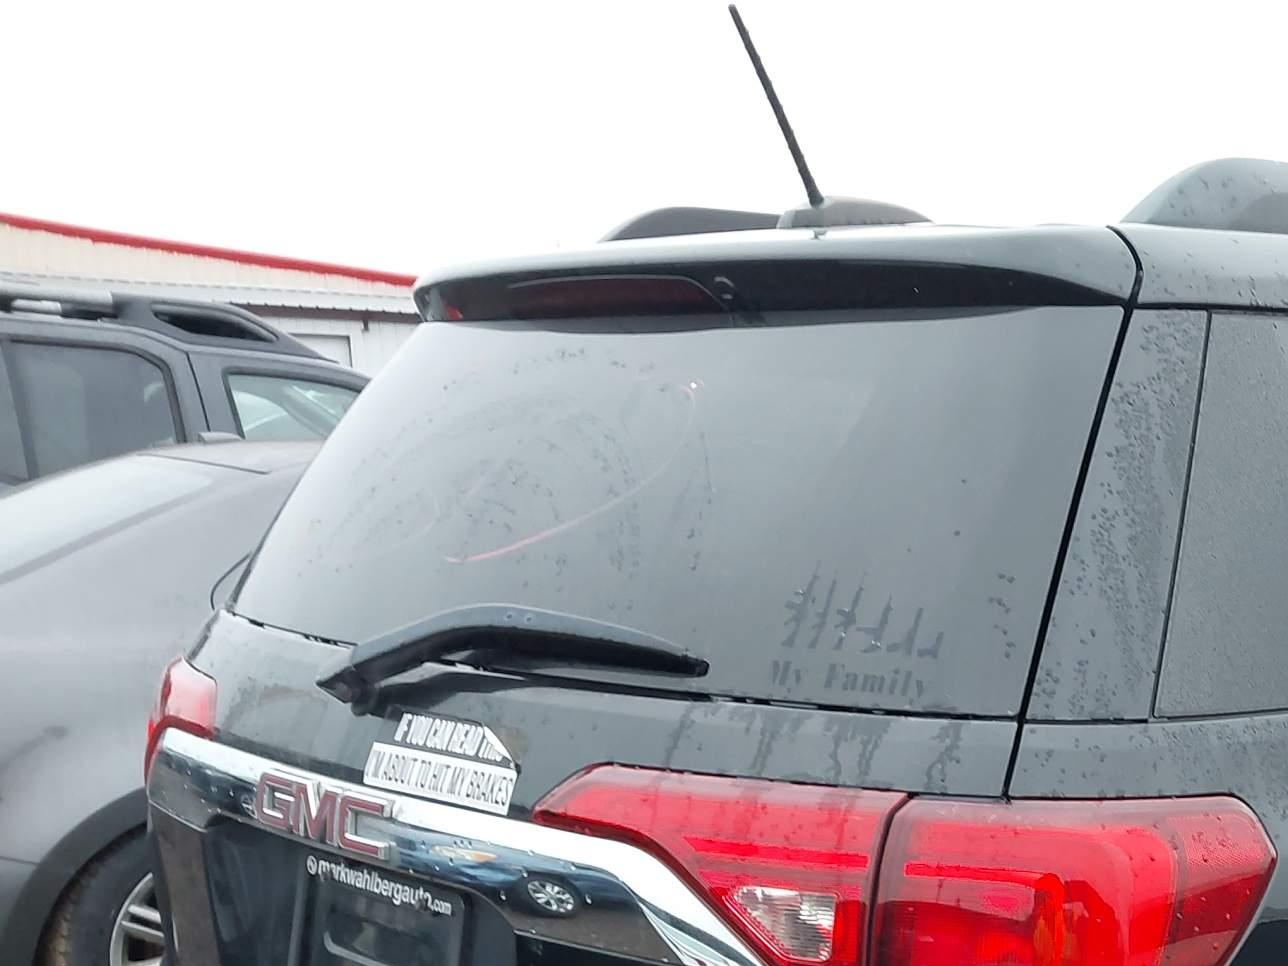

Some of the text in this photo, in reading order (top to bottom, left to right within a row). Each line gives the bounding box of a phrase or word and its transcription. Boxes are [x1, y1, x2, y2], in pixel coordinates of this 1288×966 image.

[823, 661, 928, 700] Family
[393, 712, 413, 742] IF
[405, 714, 434, 747] YOU
[426, 718, 457, 752] CAN
[447, 721, 485, 757] READ
[381, 752, 419, 785] ABOUT
[413, 758, 433, 789] TO
[427, 761, 453, 794] HIT
[445, 765, 471, 797] MY
[464, 768, 515, 807] BRAKES
[254, 770, 397, 860] GMC
